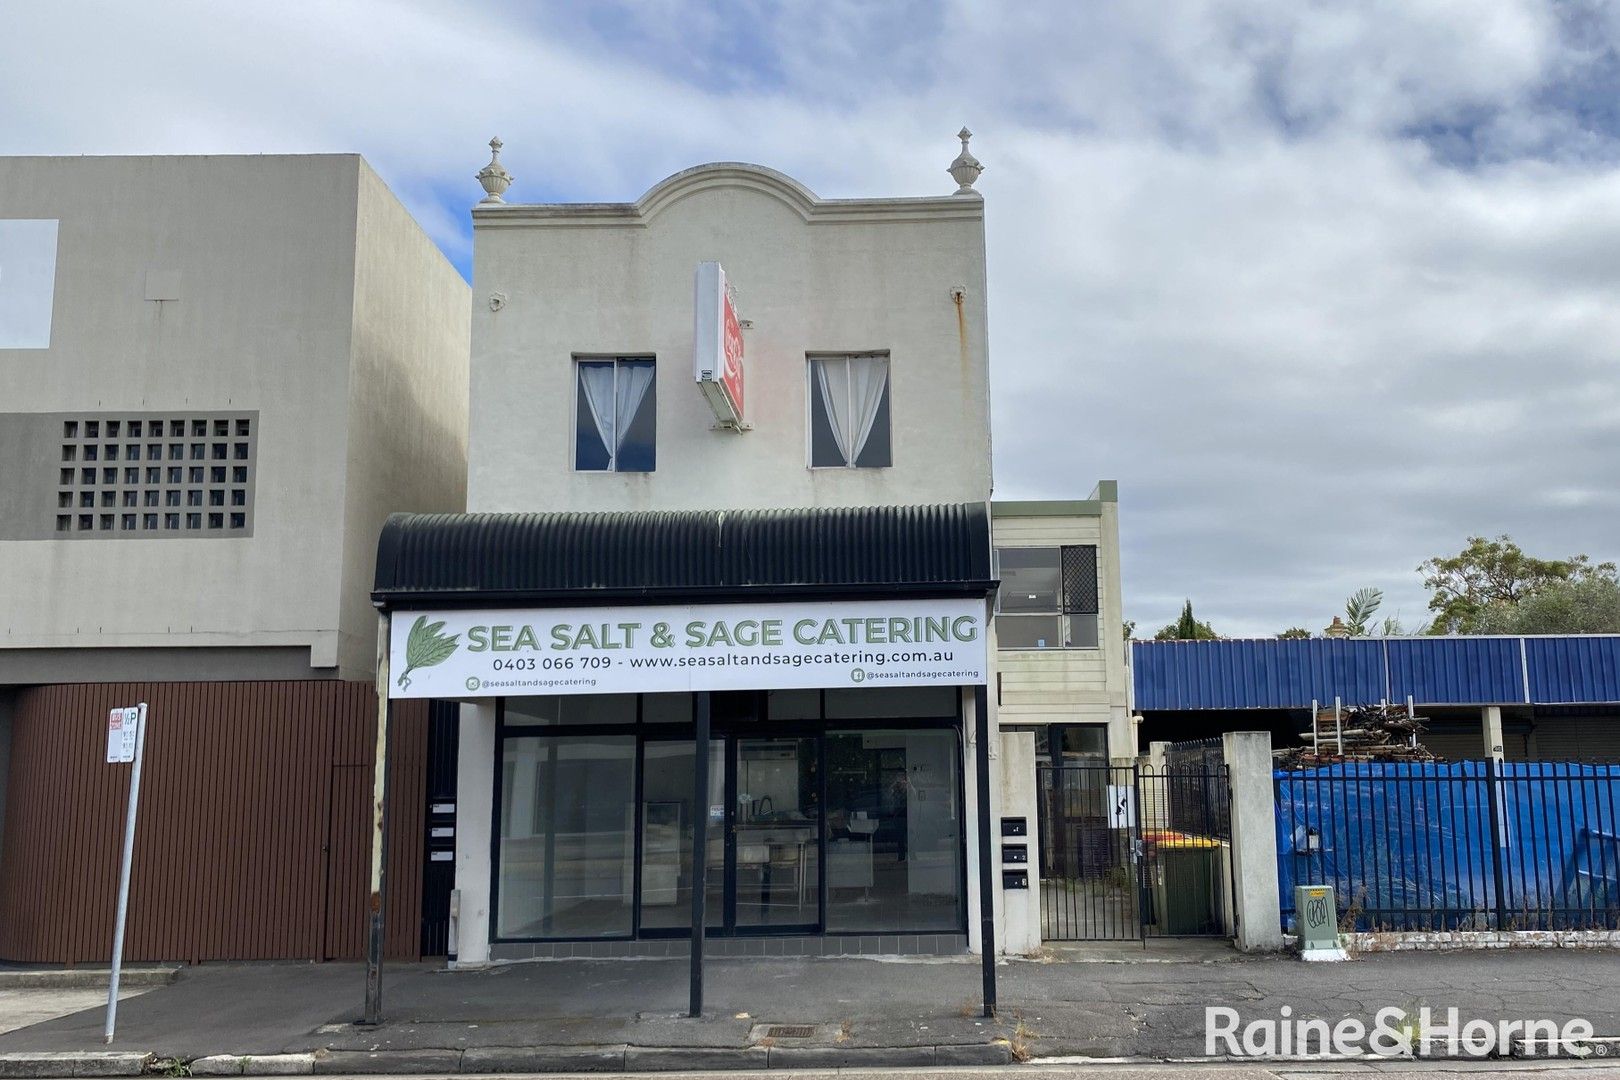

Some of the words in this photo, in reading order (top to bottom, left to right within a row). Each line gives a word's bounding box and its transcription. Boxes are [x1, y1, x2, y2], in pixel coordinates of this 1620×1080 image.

[467, 624, 541, 652] SEA
[551, 622, 642, 651] SALT
[650, 621, 676, 648] &
[685, 619, 784, 648] SAGE
[793, 615, 978, 645] CATERING
[493, 658, 536, 671] 0403
[543, 657, 574, 671] 066
[580, 656, 611, 670] 709
[630, 651, 953, 668] www.seasaltandsagecatering.com.au
[867, 670, 979, 680] @seasaltandsagecatering
[482, 678, 597, 688] @seasaltandsagecatering
